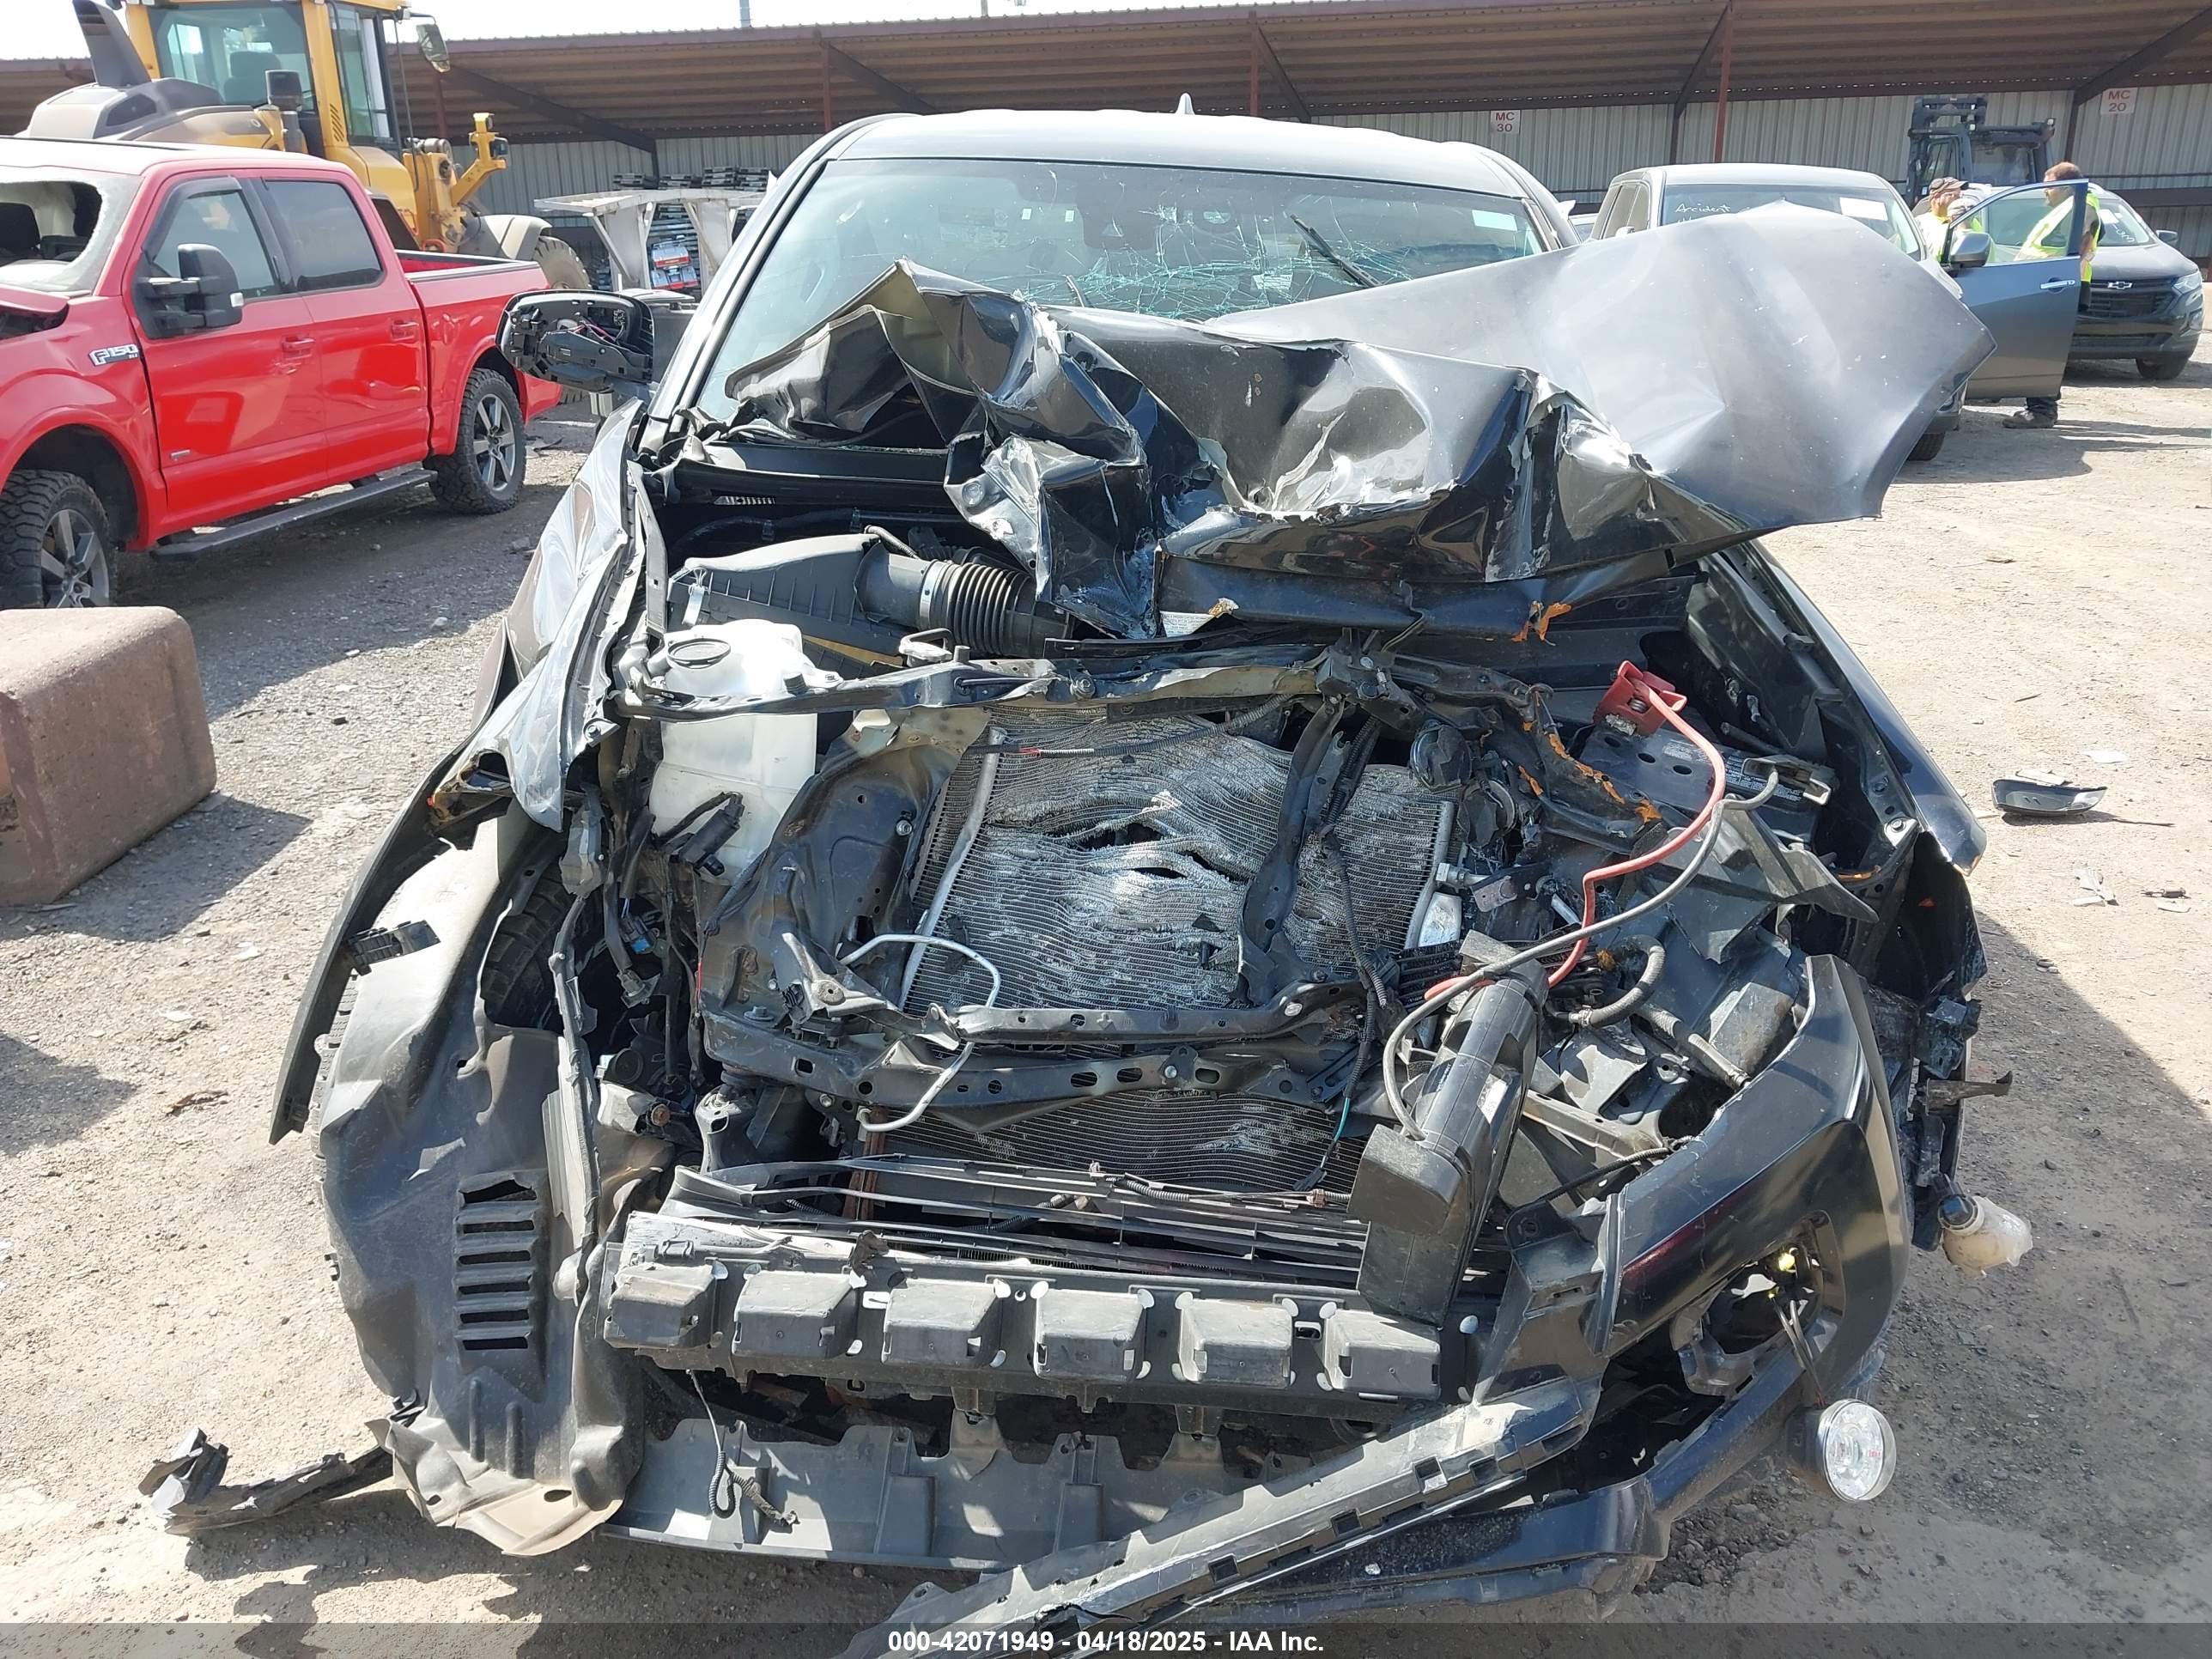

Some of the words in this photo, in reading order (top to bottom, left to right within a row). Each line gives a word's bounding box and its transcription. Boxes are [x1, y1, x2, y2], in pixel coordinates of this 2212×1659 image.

[2109, 90, 2130, 100] MC
[2109, 102, 2127, 112] 20
[1496, 112, 1515, 121] MC
[1498, 123, 1512, 132] 30
